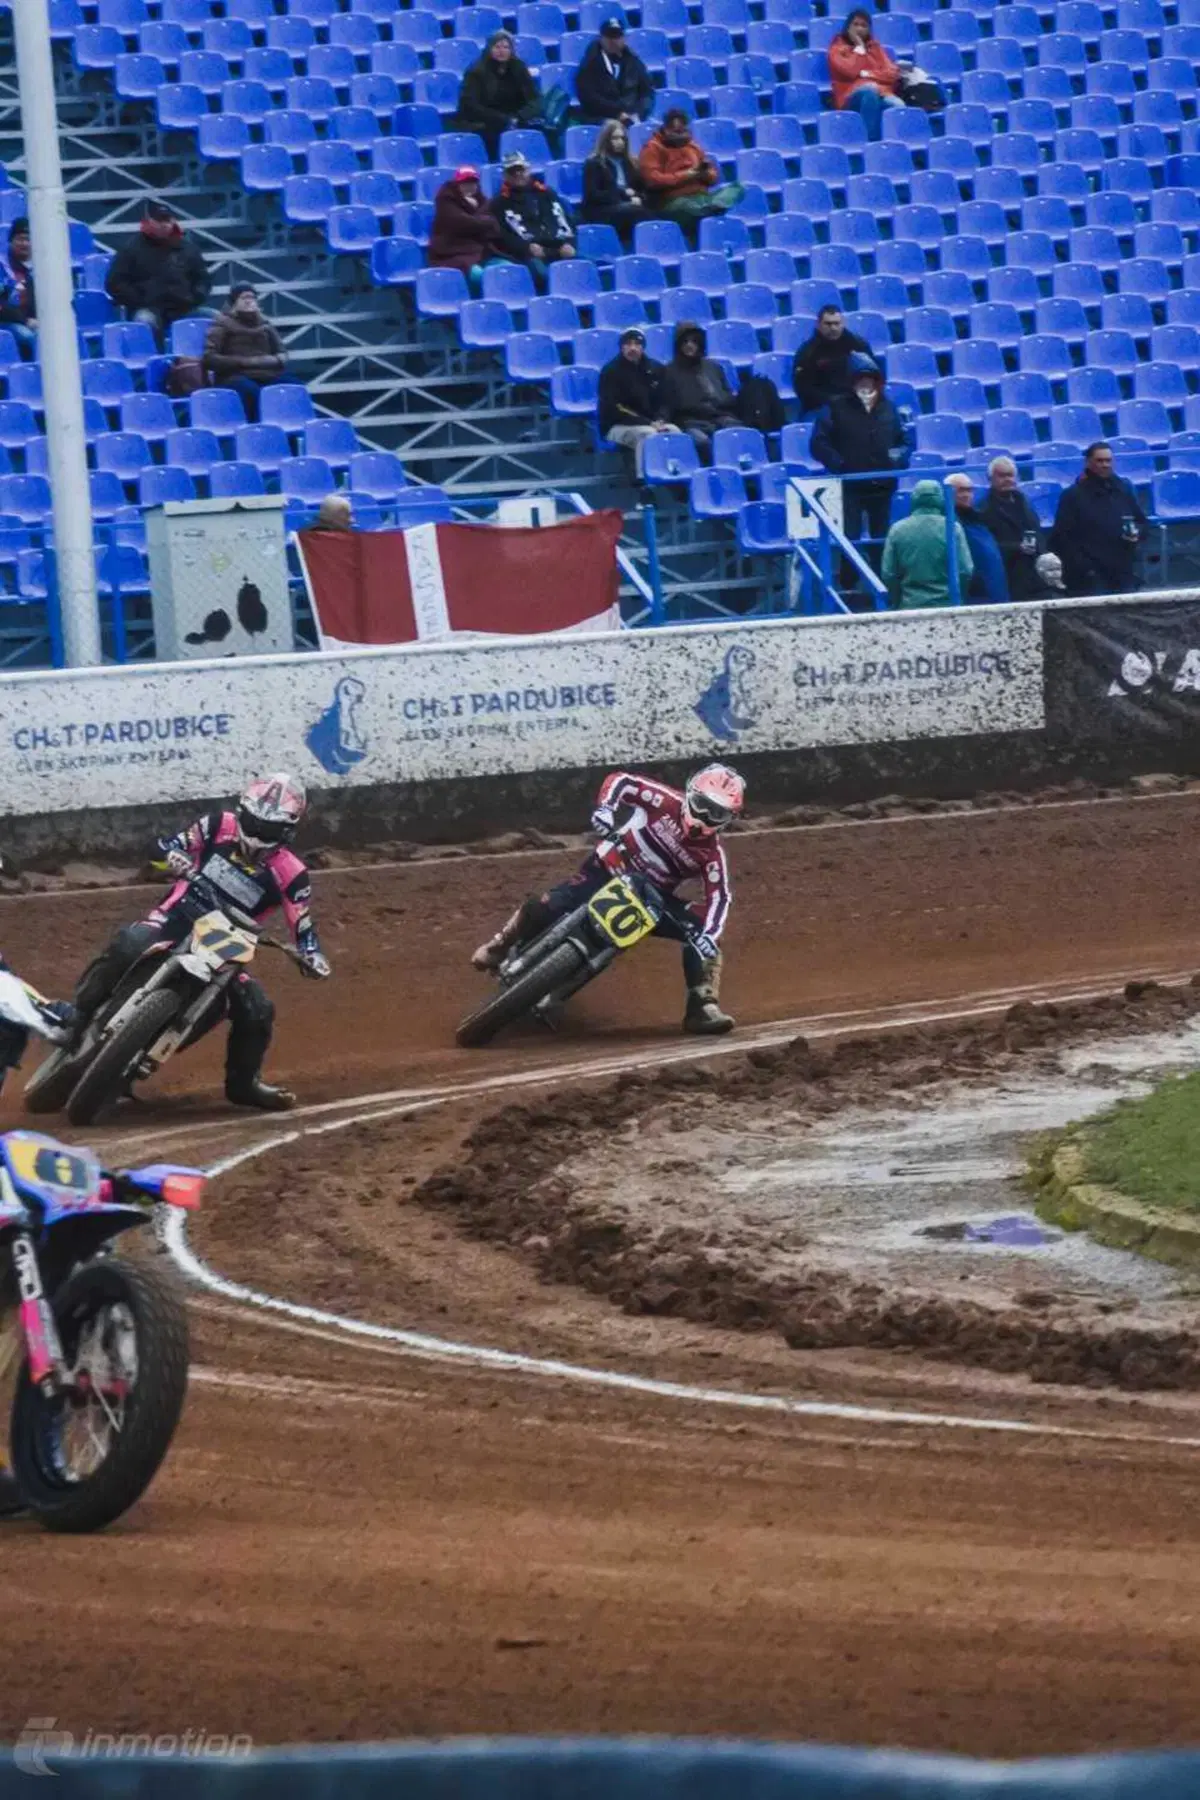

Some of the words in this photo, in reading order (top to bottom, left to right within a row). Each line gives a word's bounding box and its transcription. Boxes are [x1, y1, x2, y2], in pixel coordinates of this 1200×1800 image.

[403, 694, 464, 720] CH&T
[470, 683, 616, 714] PARDUBICE
[14, 723, 78, 751] CH&T
[84, 713, 232, 746] PARDUBICE
[592, 884, 644, 939] 70
